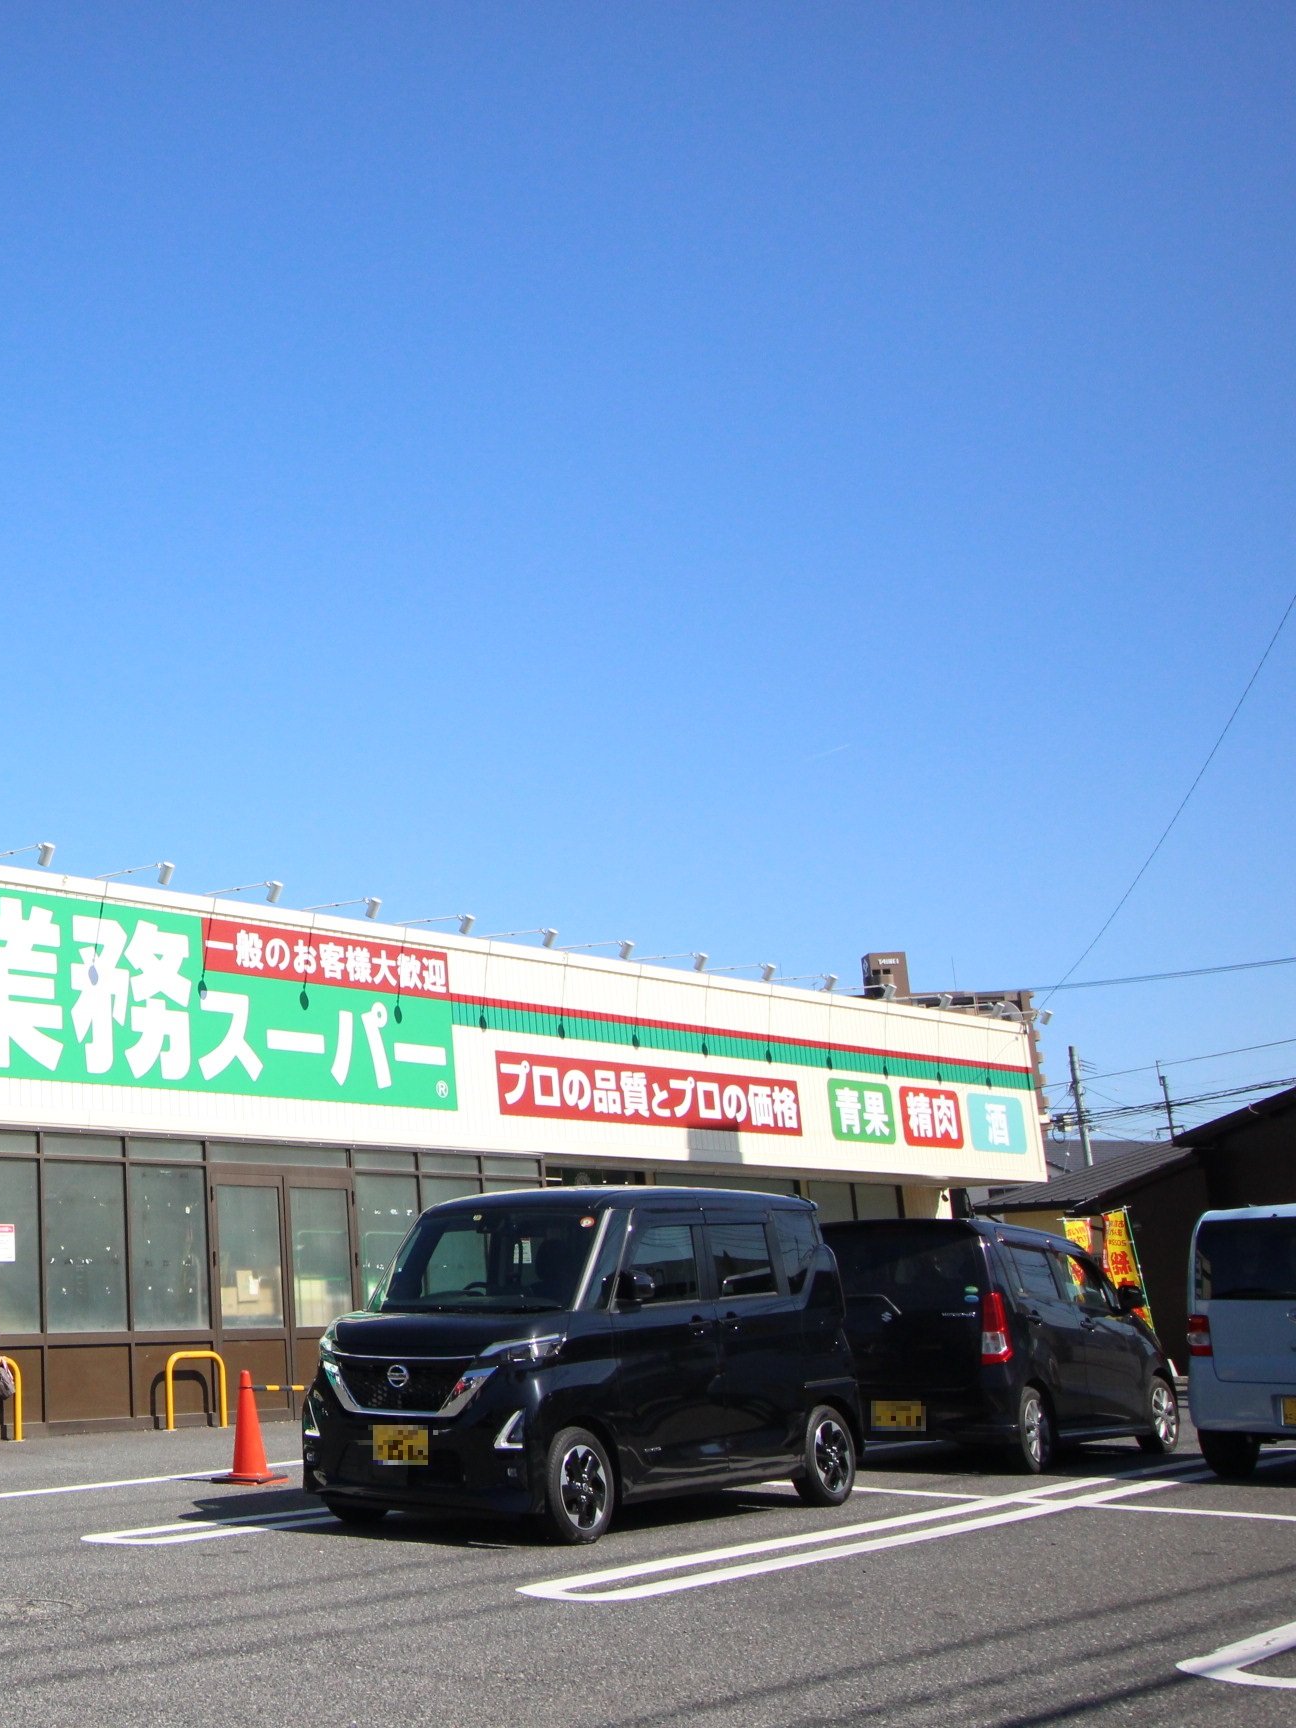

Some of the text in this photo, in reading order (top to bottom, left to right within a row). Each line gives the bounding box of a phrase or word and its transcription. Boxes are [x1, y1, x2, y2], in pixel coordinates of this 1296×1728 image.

[204, 929, 448, 994] 一般のお客様大歓迎
[499, 1060, 799, 1130] プロの品質とプロの価格
[835, 1086, 891, 1138] 青果
[906, 1092, 959, 1141] 精肉
[986, 1102, 1010, 1147] 酒
